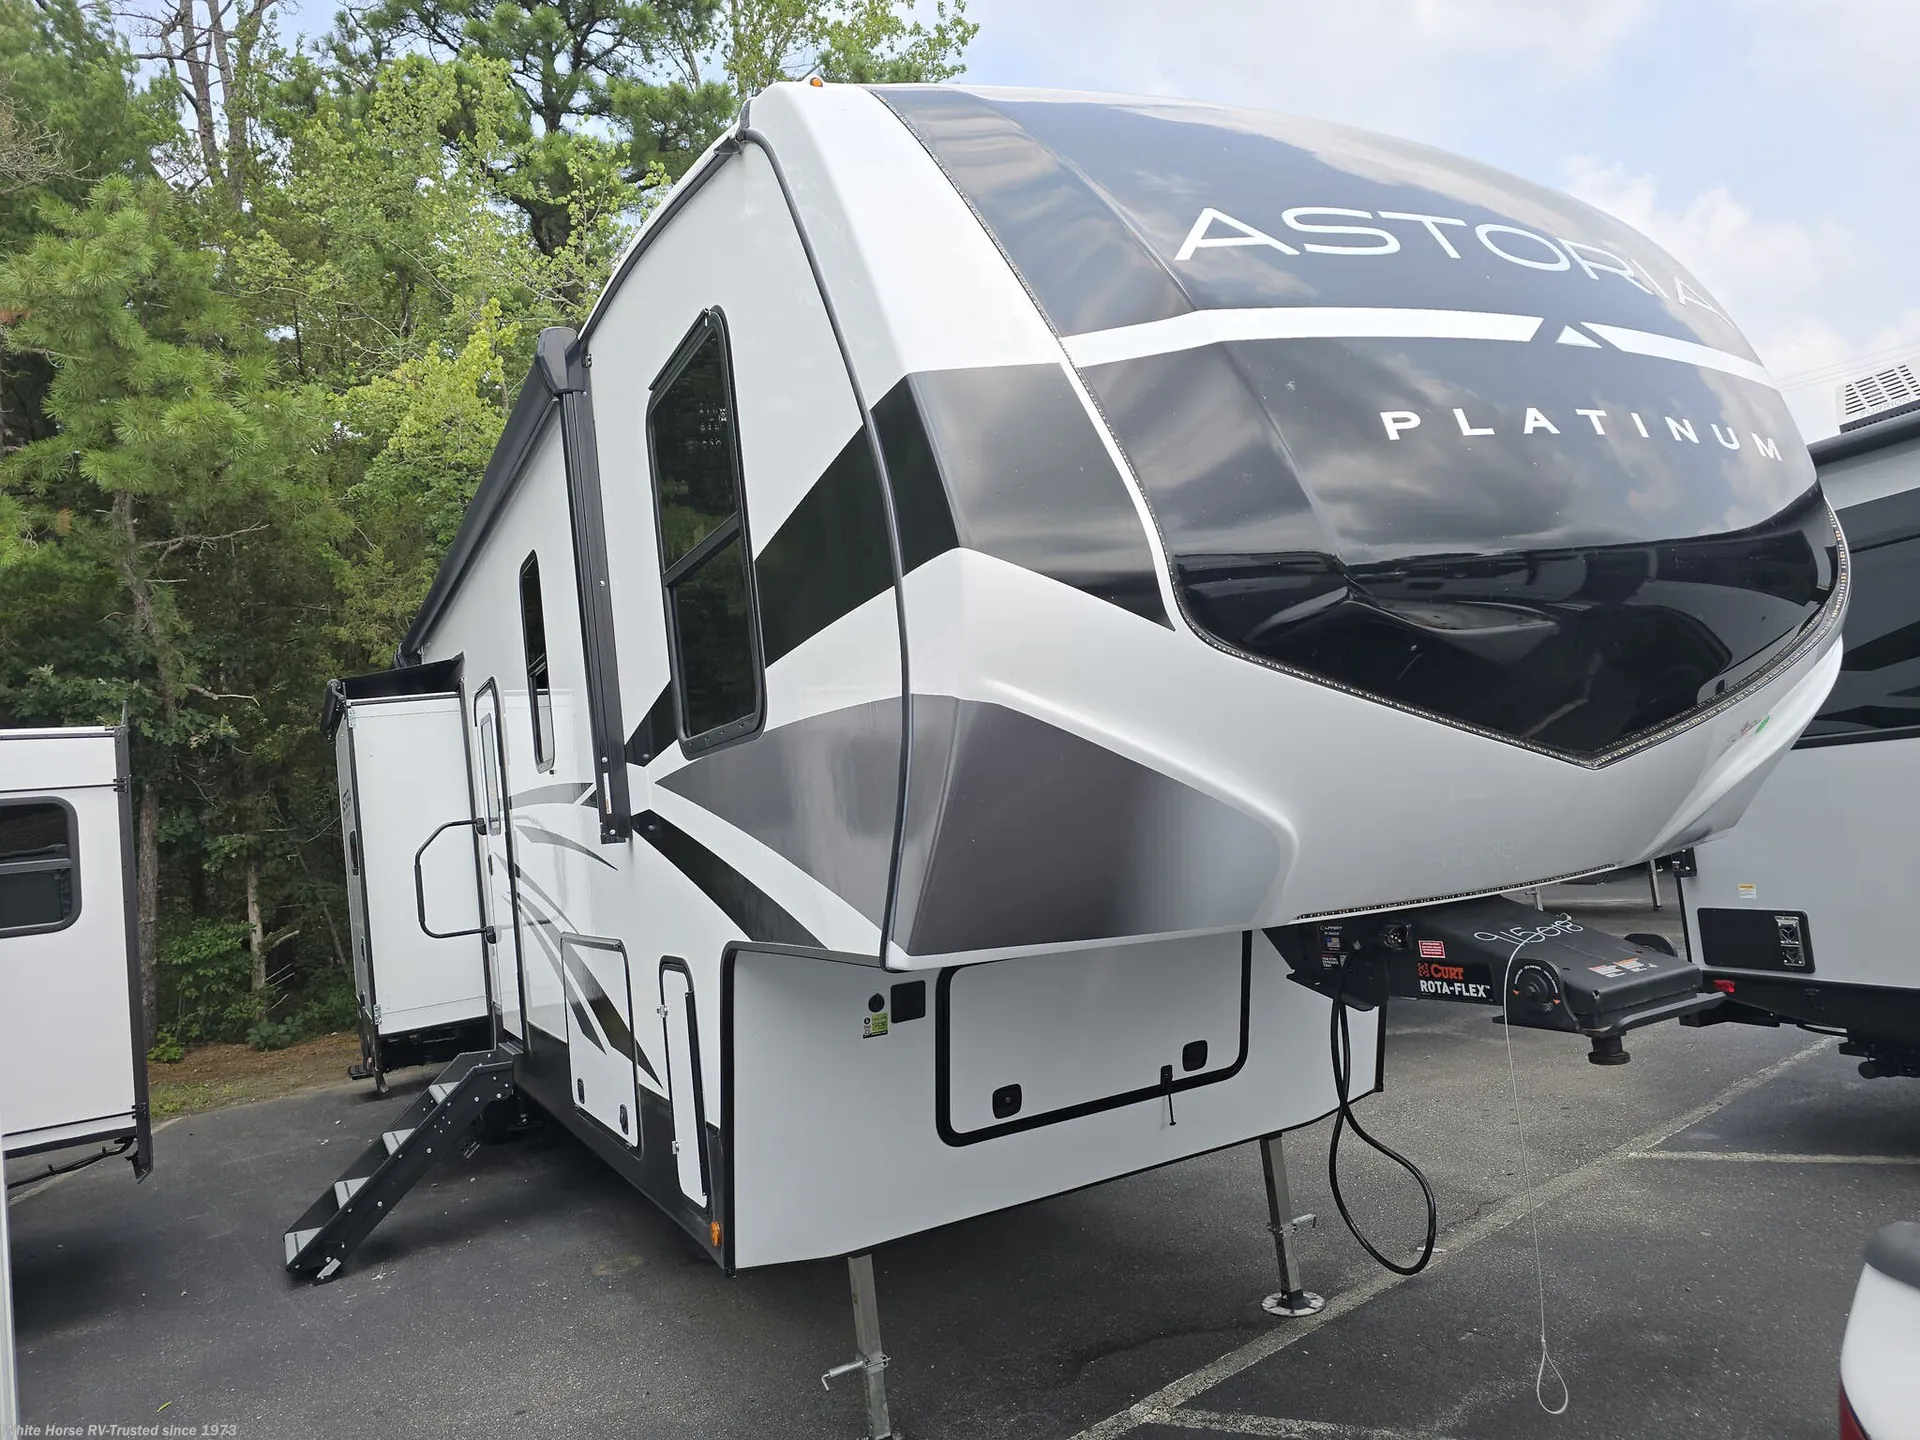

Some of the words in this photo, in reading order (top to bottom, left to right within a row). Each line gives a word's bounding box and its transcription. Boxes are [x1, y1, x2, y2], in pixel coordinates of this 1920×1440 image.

[1174, 207, 1735, 329] ASTORIA
[1380, 407, 1783, 462] PLATINUM
[1430, 964, 1464, 980] CURT
